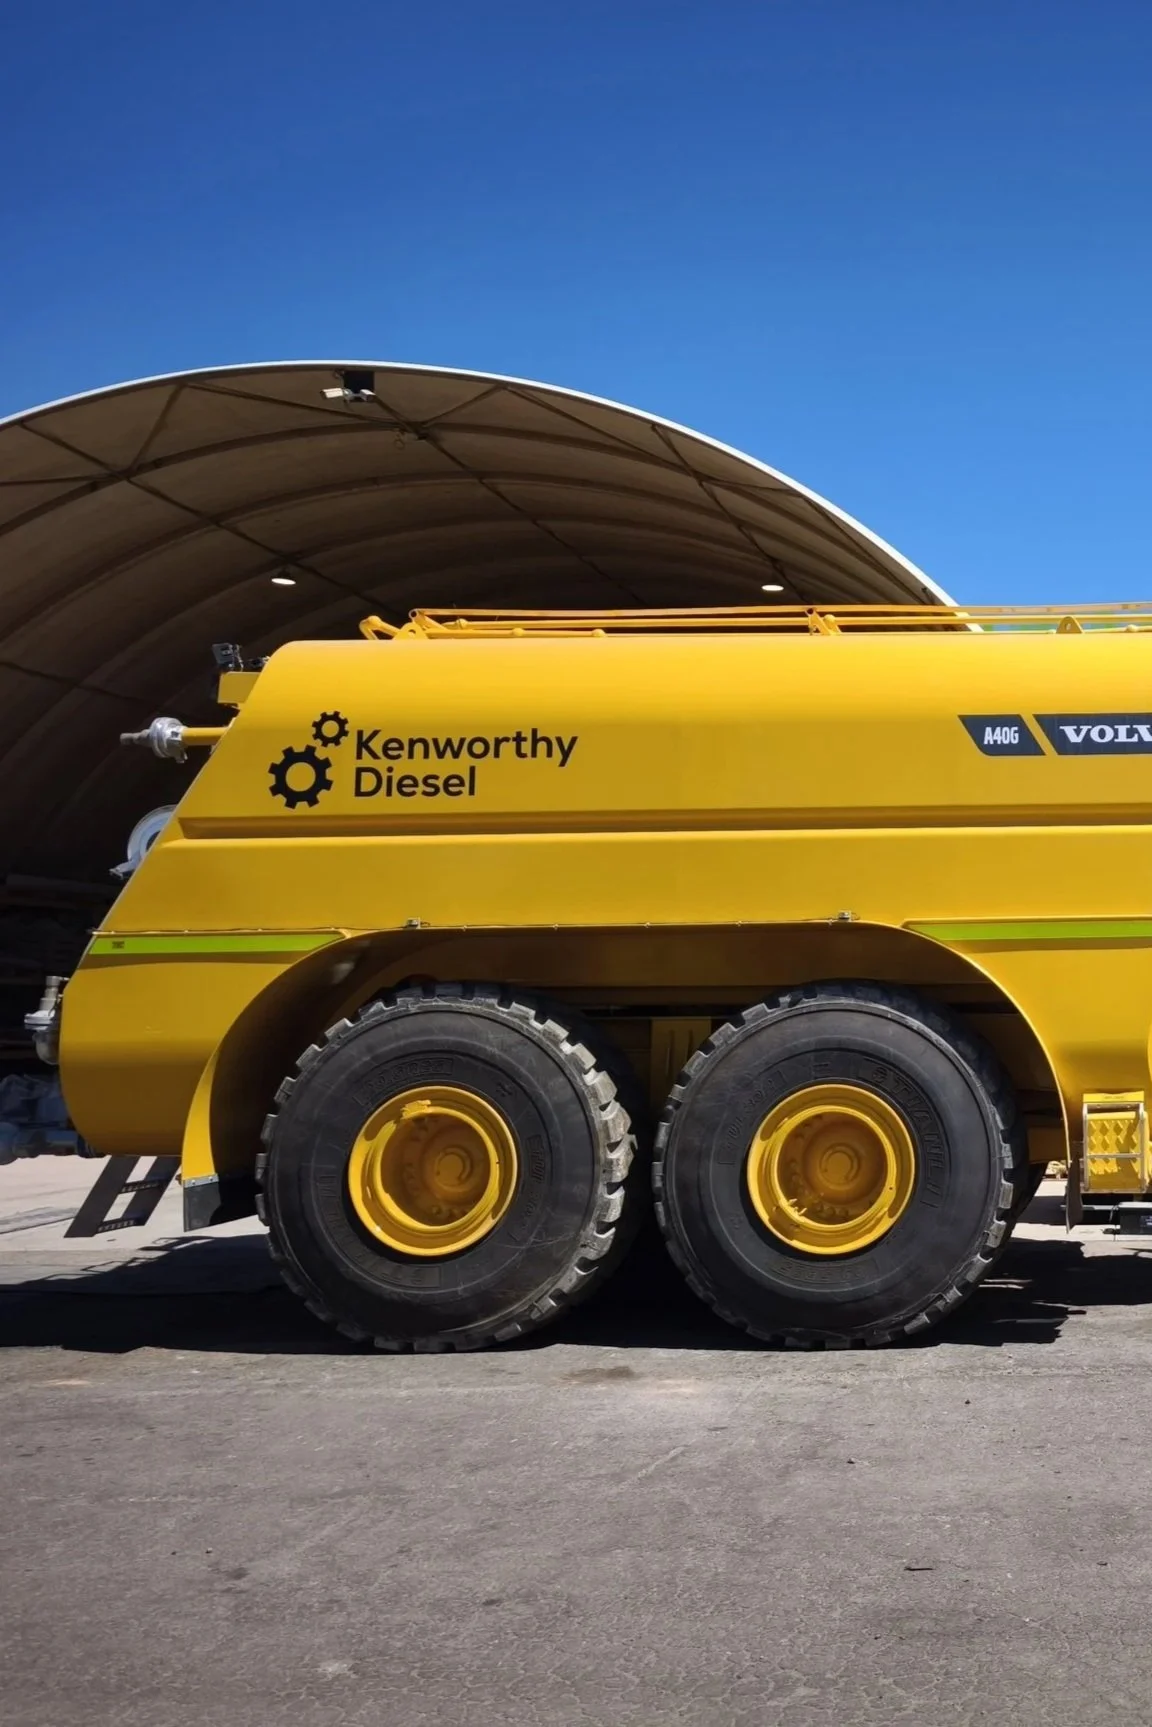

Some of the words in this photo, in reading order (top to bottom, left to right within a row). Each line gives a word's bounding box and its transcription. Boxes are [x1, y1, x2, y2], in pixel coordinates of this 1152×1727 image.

[355, 728, 578, 767] Kenworthy
[983, 726, 1019, 745] A40G
[354, 766, 476, 797] Diesel
